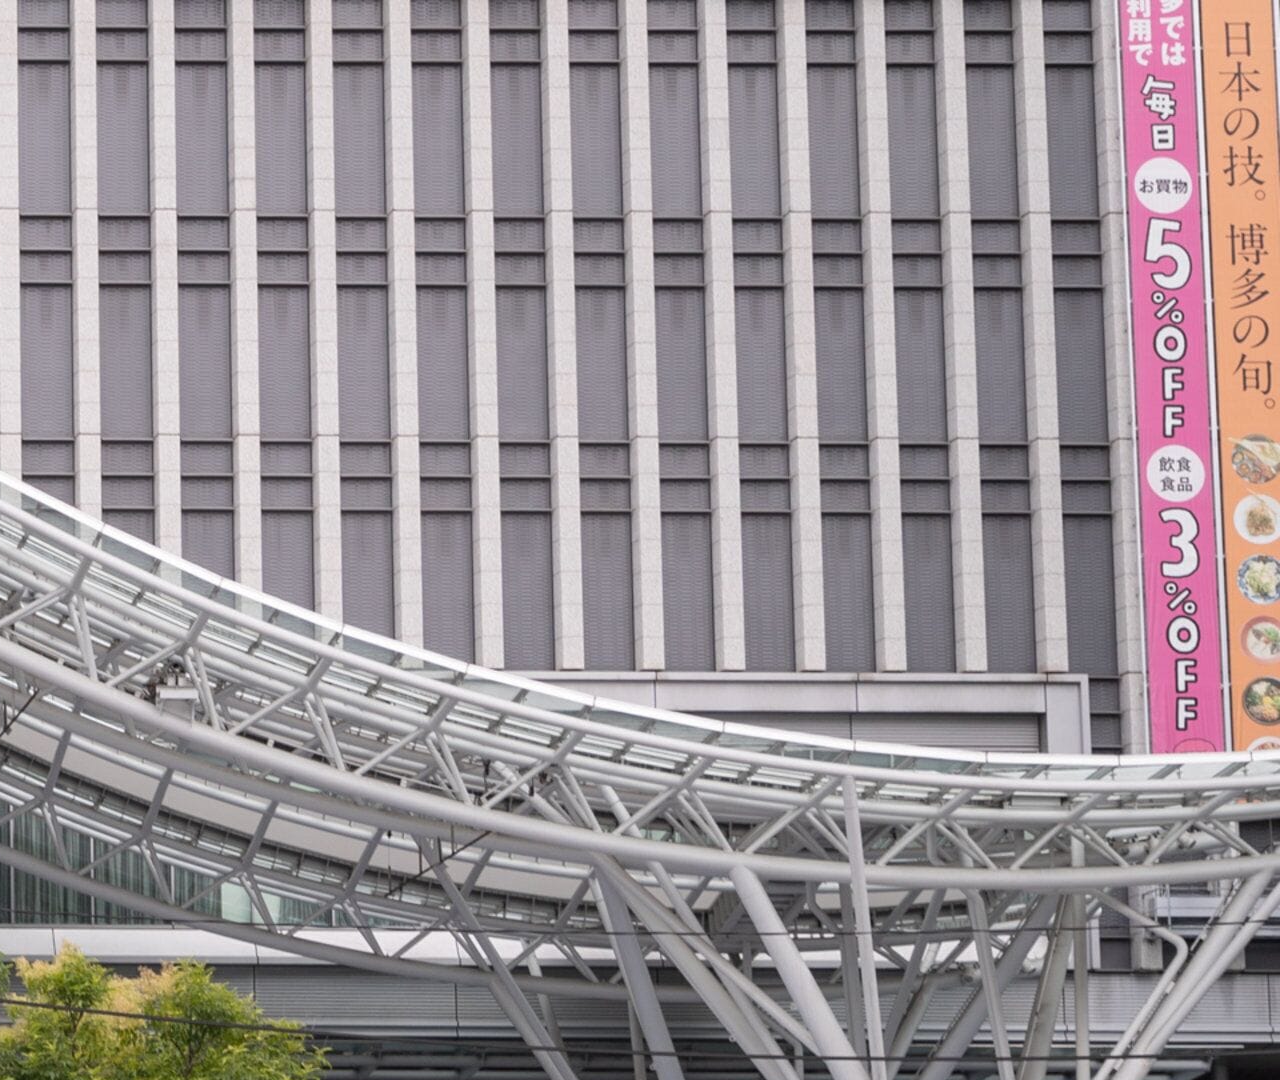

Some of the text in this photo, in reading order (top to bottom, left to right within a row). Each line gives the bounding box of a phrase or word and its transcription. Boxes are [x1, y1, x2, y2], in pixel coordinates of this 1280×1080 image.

[1140, 74, 1177, 151] 毎日
[1139, 178, 1188, 195] お買物
[1159, 456, 1192, 474] 飲食
[1160, 476, 1193, 492] 食品
